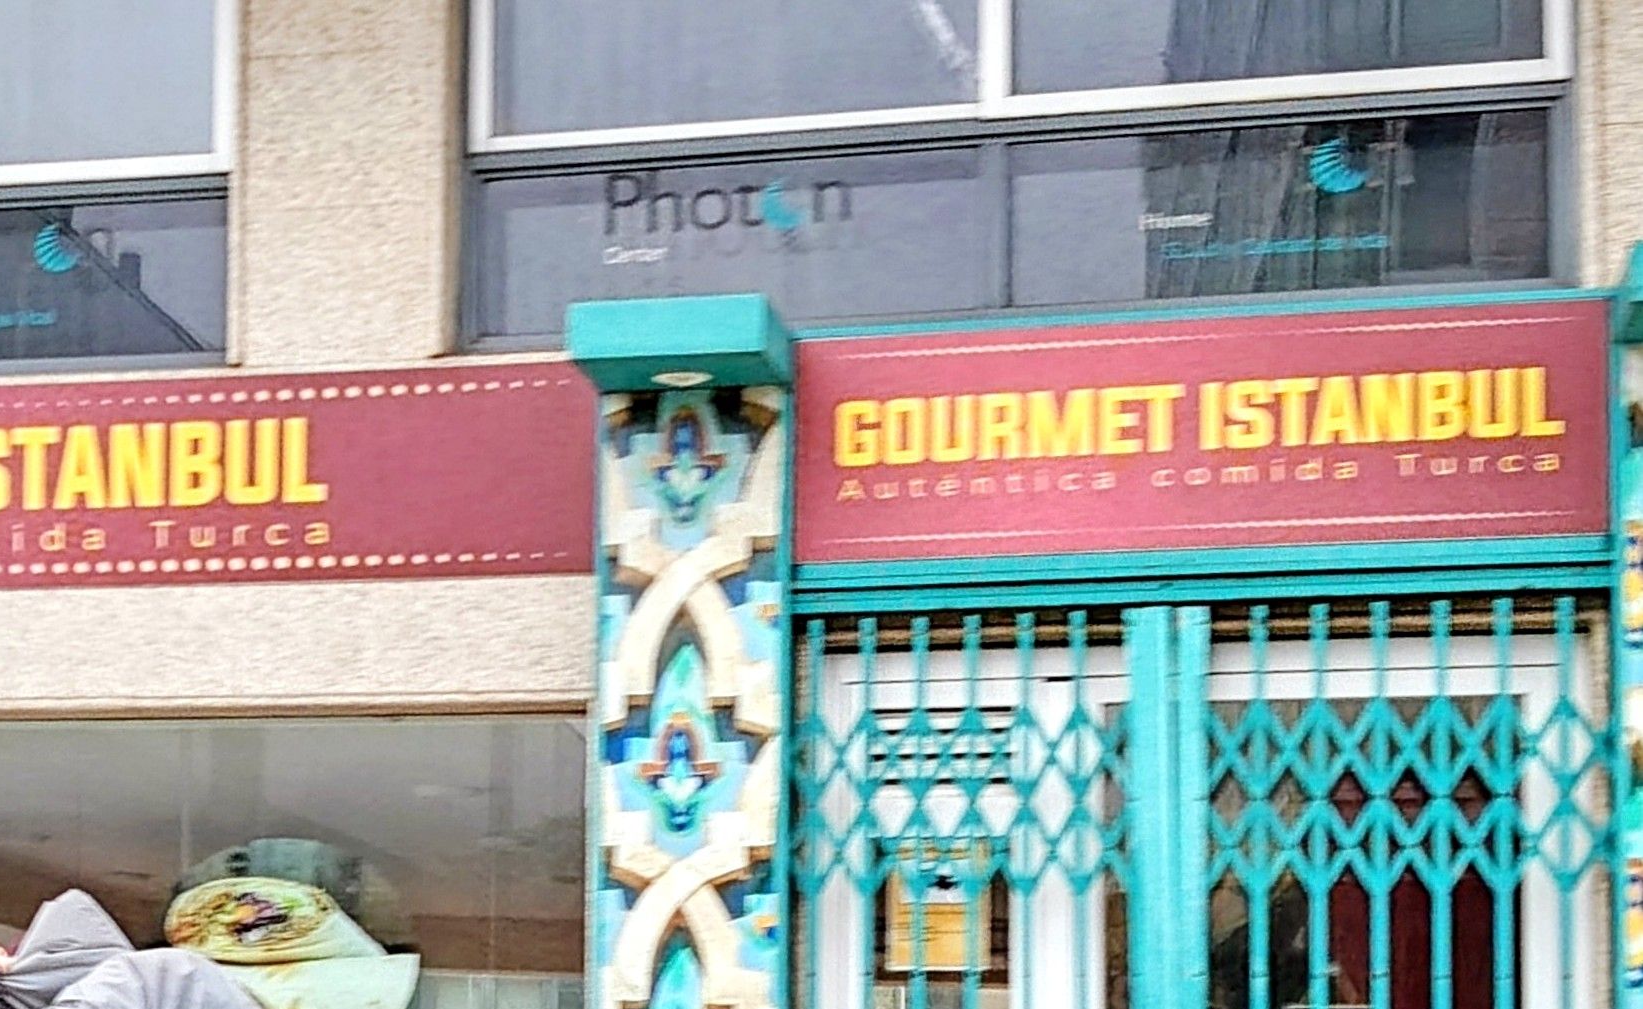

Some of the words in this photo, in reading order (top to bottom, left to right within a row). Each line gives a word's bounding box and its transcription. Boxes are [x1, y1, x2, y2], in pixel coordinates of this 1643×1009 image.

[833, 383, 1187, 468] GOURMET
[1198, 366, 1567, 450] ISTANBUL
[1150, 456, 1358, 492] comida
[1393, 452, 1561, 478] Turca
[148, 519, 331, 549] Turca
